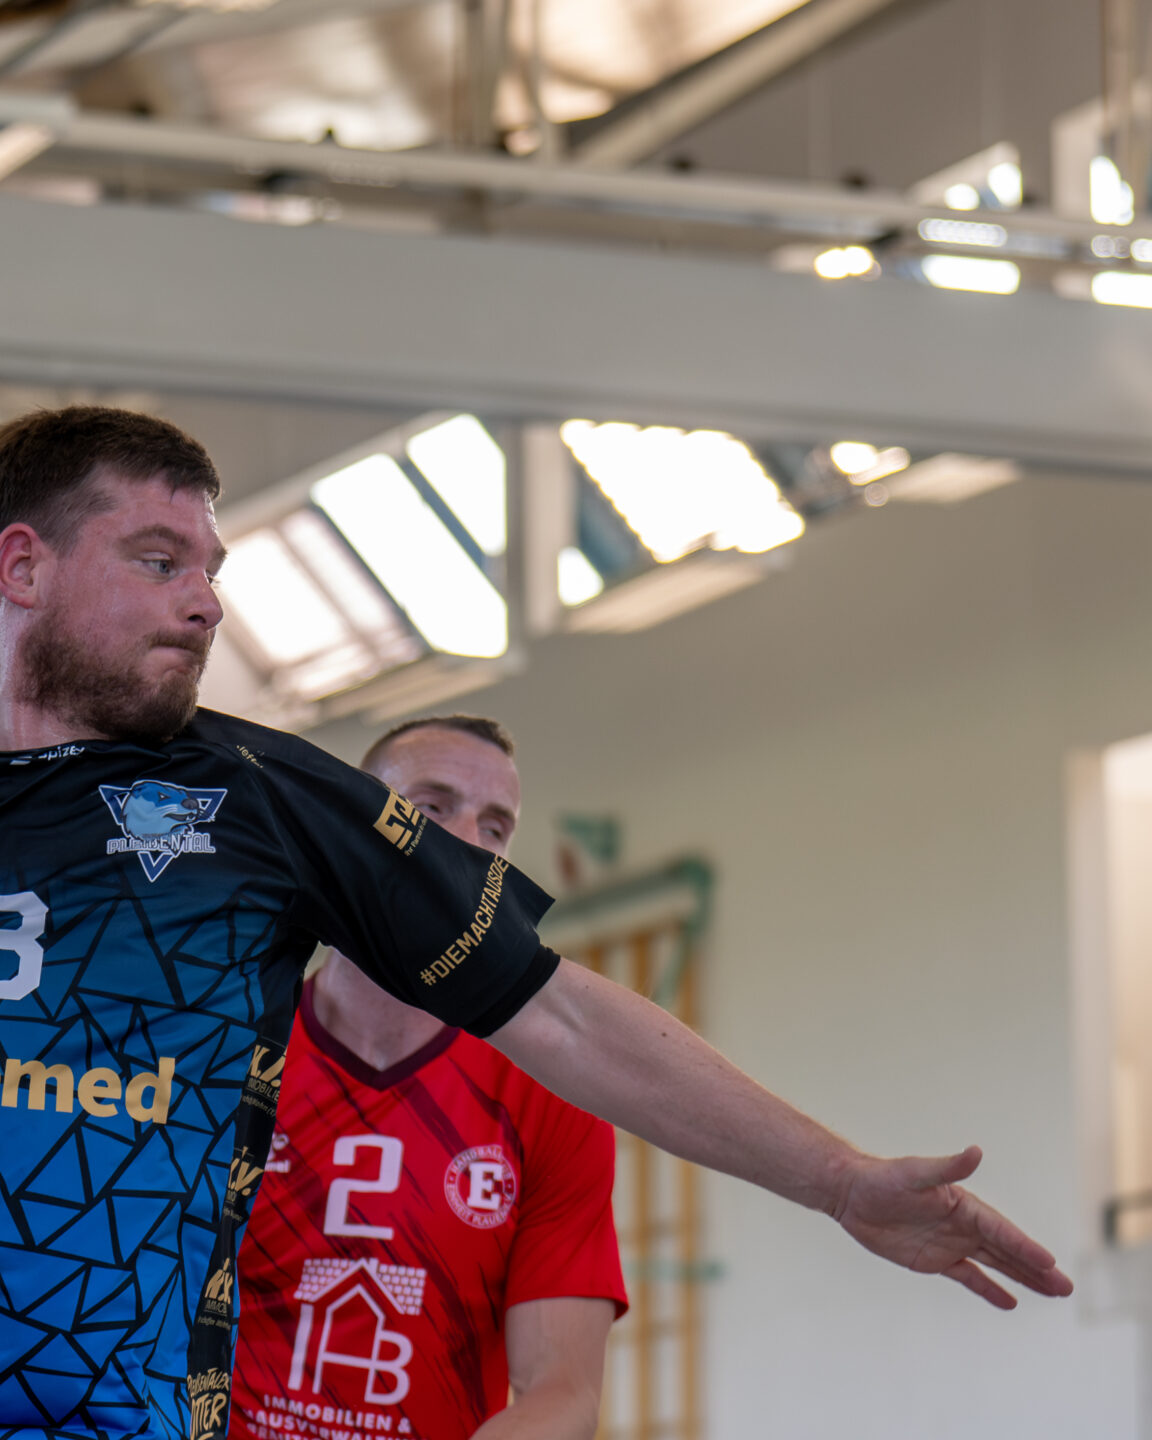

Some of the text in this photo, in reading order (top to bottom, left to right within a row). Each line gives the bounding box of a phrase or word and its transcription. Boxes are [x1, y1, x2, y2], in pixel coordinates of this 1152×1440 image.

[323, 1133, 404, 1241] 2
[466, 1161, 504, 1211] E
[263, 1393, 412, 1434] IMMOBILIEN &
